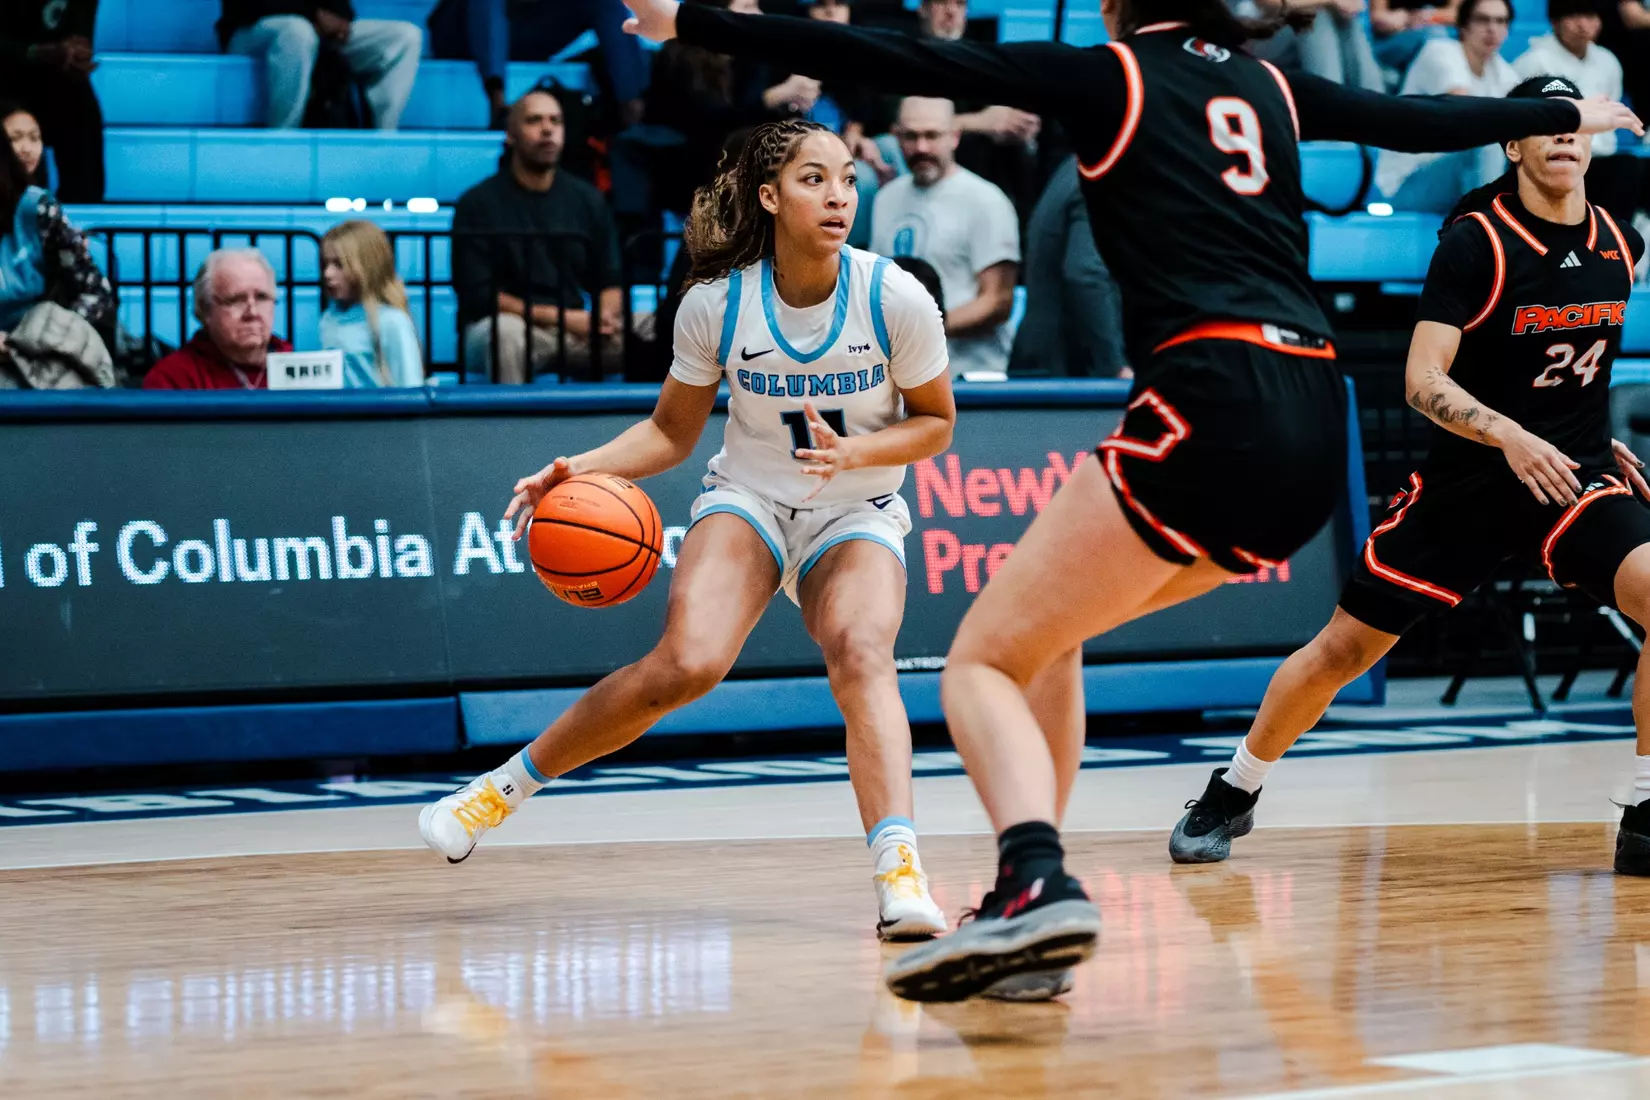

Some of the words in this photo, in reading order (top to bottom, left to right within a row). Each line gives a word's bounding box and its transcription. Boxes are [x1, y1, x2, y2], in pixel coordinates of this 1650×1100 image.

[1205, 96, 1271, 196] 9
[737, 363, 885, 397] COLUMBIA
[1532, 339, 1608, 387] 24
[24, 521, 100, 587] of
[116, 515, 435, 585] Columbia
